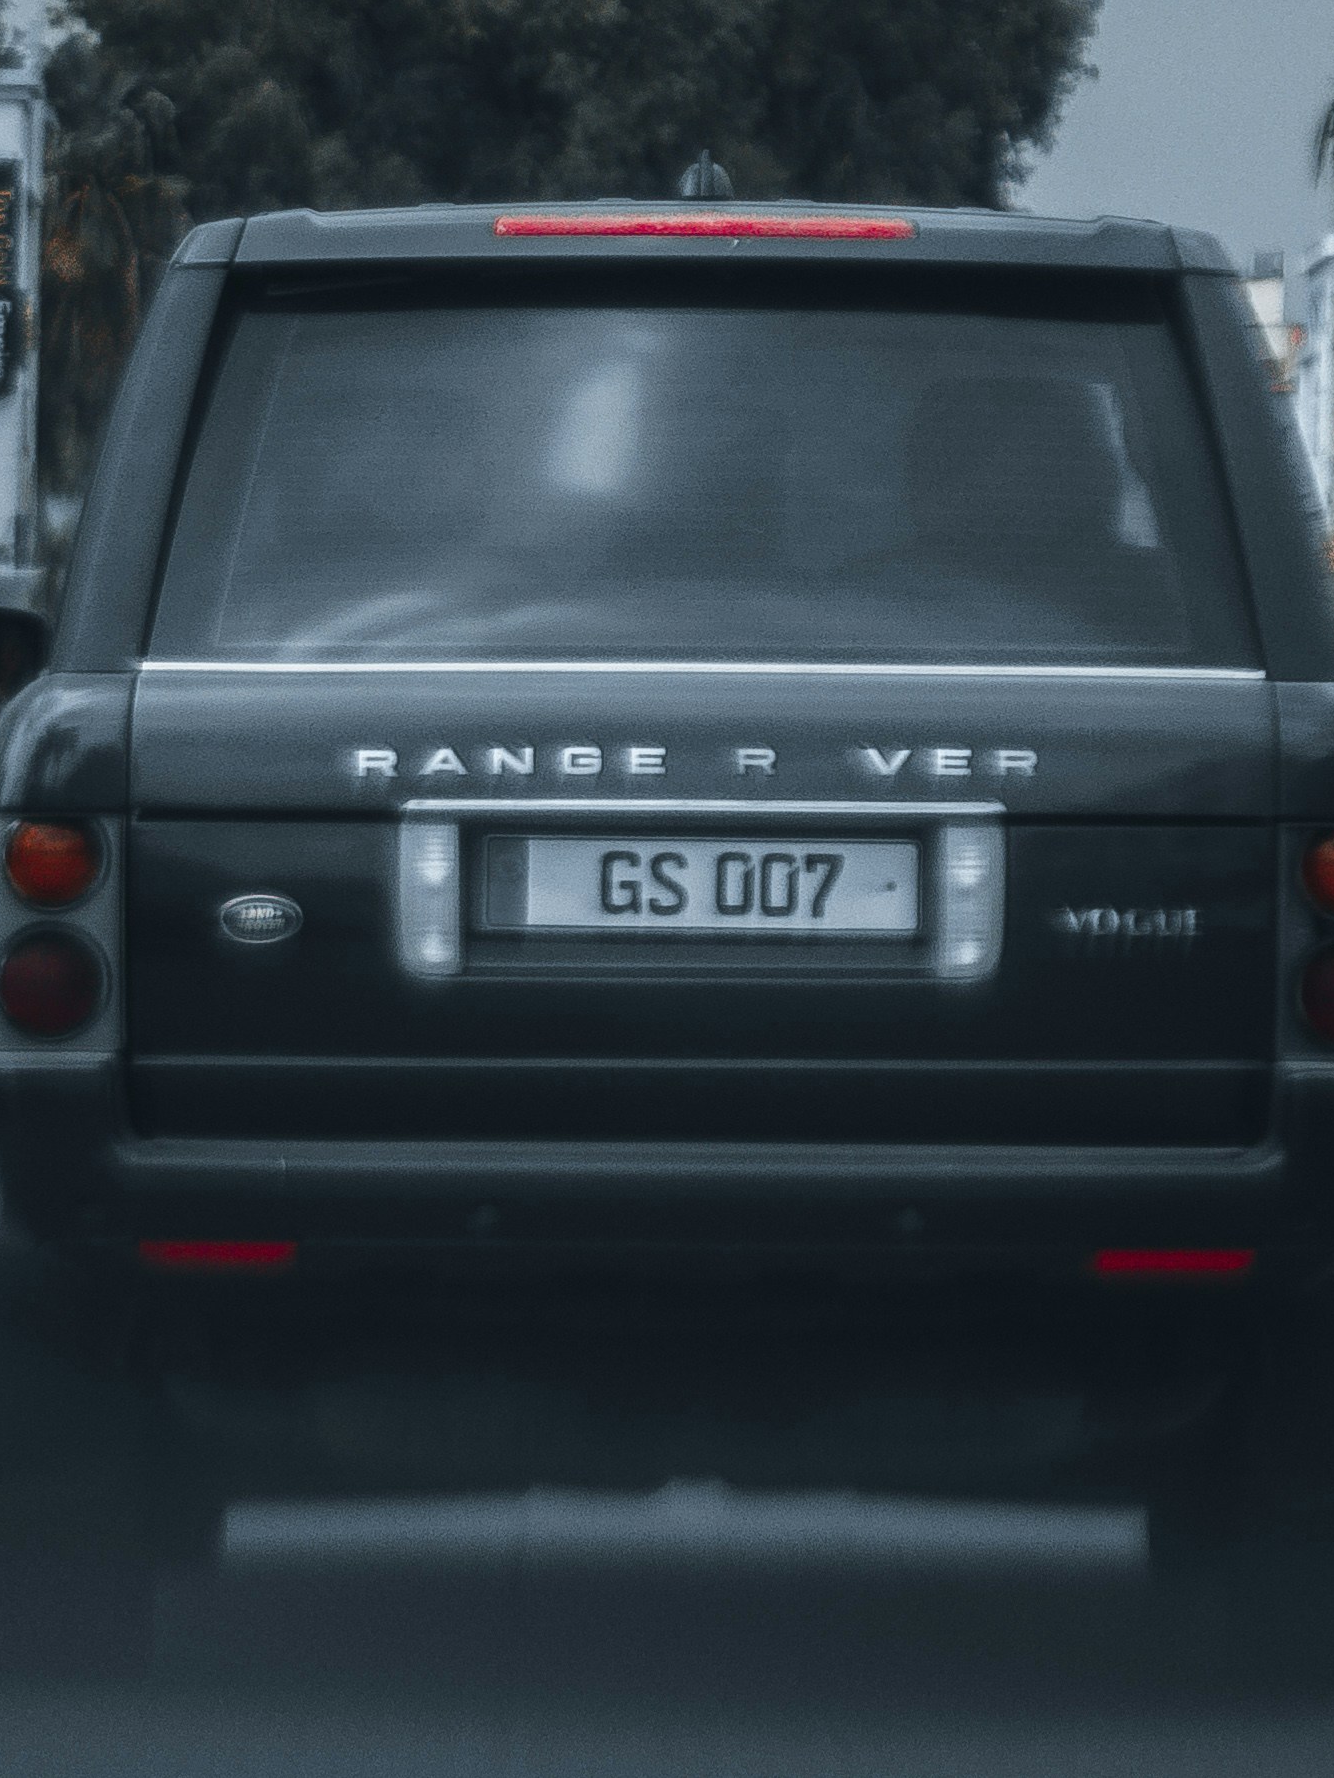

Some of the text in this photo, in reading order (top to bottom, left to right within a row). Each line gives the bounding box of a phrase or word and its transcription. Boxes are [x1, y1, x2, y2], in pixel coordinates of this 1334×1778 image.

[356, 746, 1038, 779] RANGE RVER
[600, 849, 846, 919] GS 007
